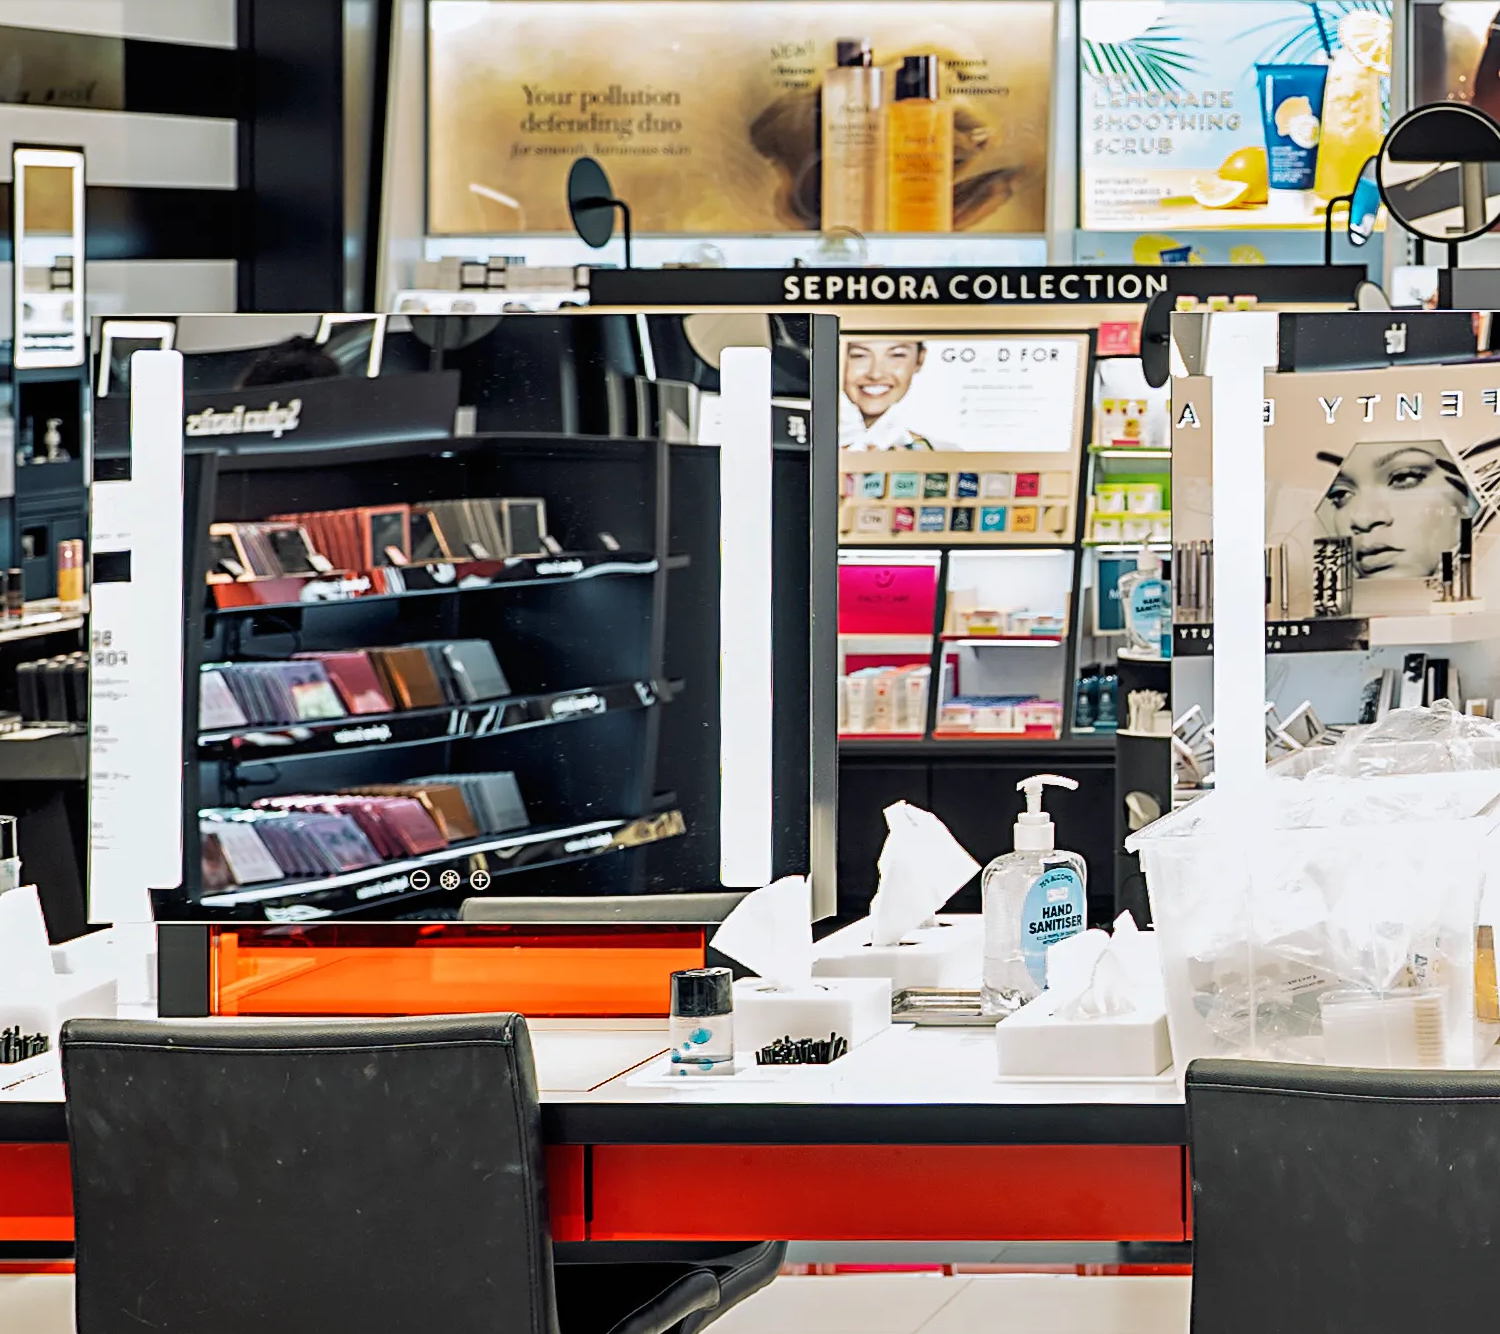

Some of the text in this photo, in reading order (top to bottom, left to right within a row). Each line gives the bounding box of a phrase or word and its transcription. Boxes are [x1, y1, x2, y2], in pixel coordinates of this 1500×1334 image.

[521, 83, 681, 113] Your pollution
[1094, 90, 1234, 108] LEMONADE
[520, 112, 683, 140] defending duo
[1092, 113, 1243, 131] SMOOTHING
[1093, 137, 1175, 155] SCRUB
[784, 272, 1169, 301] SEPHORA COLLECTION
[941, 347, 1011, 363] GOD
[1042, 903, 1073, 920] HAND
[1029, 914, 1082, 934] SANITISER
